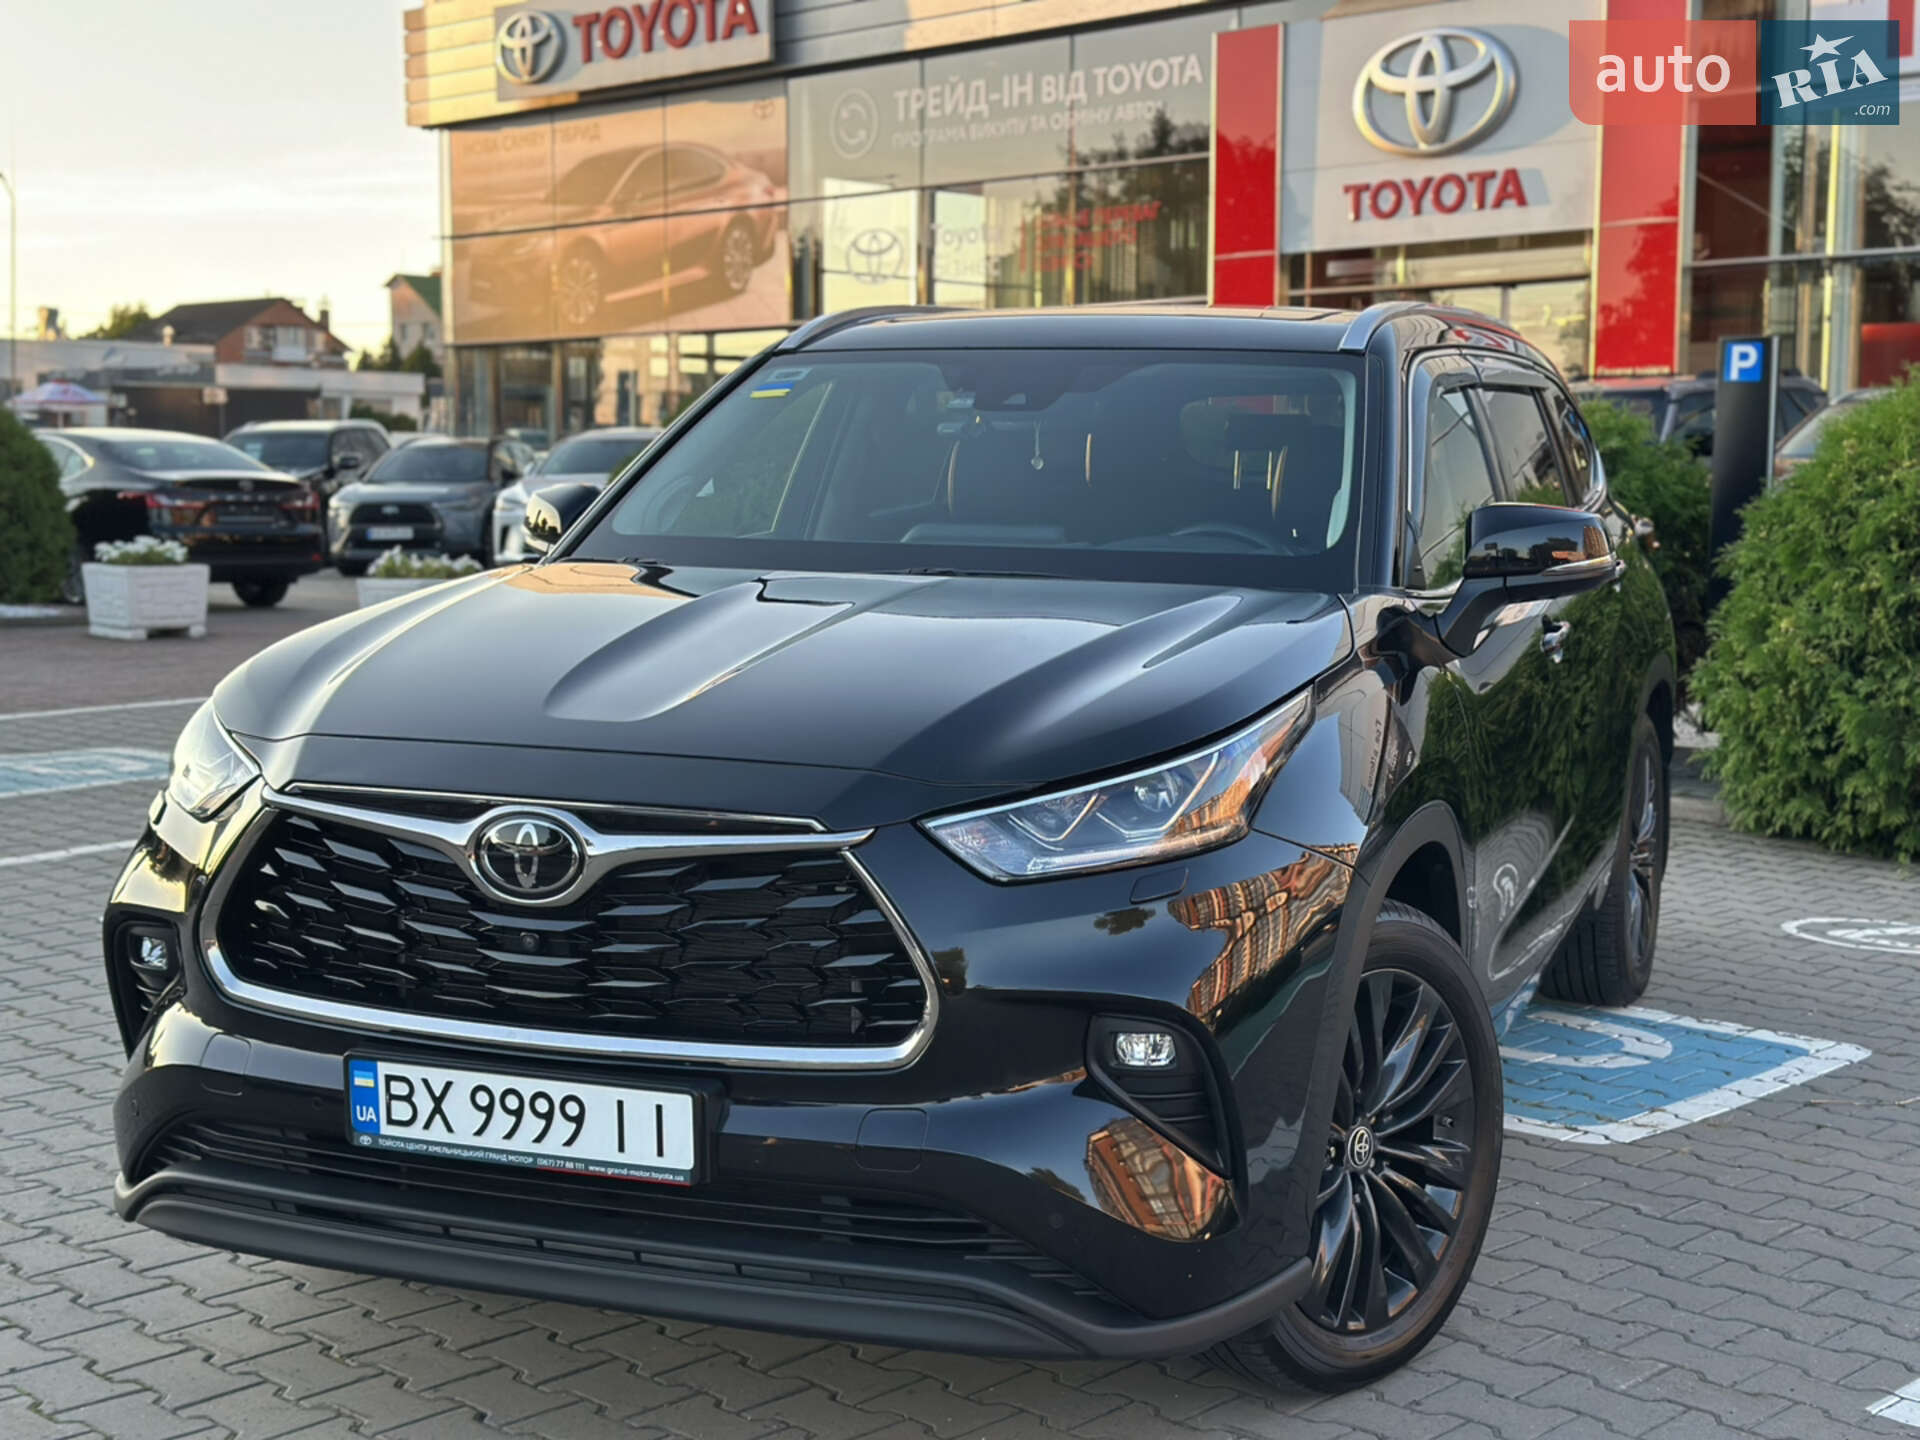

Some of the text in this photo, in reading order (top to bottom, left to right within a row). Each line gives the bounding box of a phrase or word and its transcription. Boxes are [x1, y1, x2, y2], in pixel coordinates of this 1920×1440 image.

[573, 0, 758, 63] TOYOTA
[894, 54, 1203, 122] ТРЕЙД-ІН ВІД TOYOTA
[1343, 168, 1528, 222] TOYOTA
[1730, 343, 1758, 381] P
[356, 1105, 377, 1123] UA
[384, 1073, 455, 1133] BX
[469, 1083, 586, 1148] 9999
